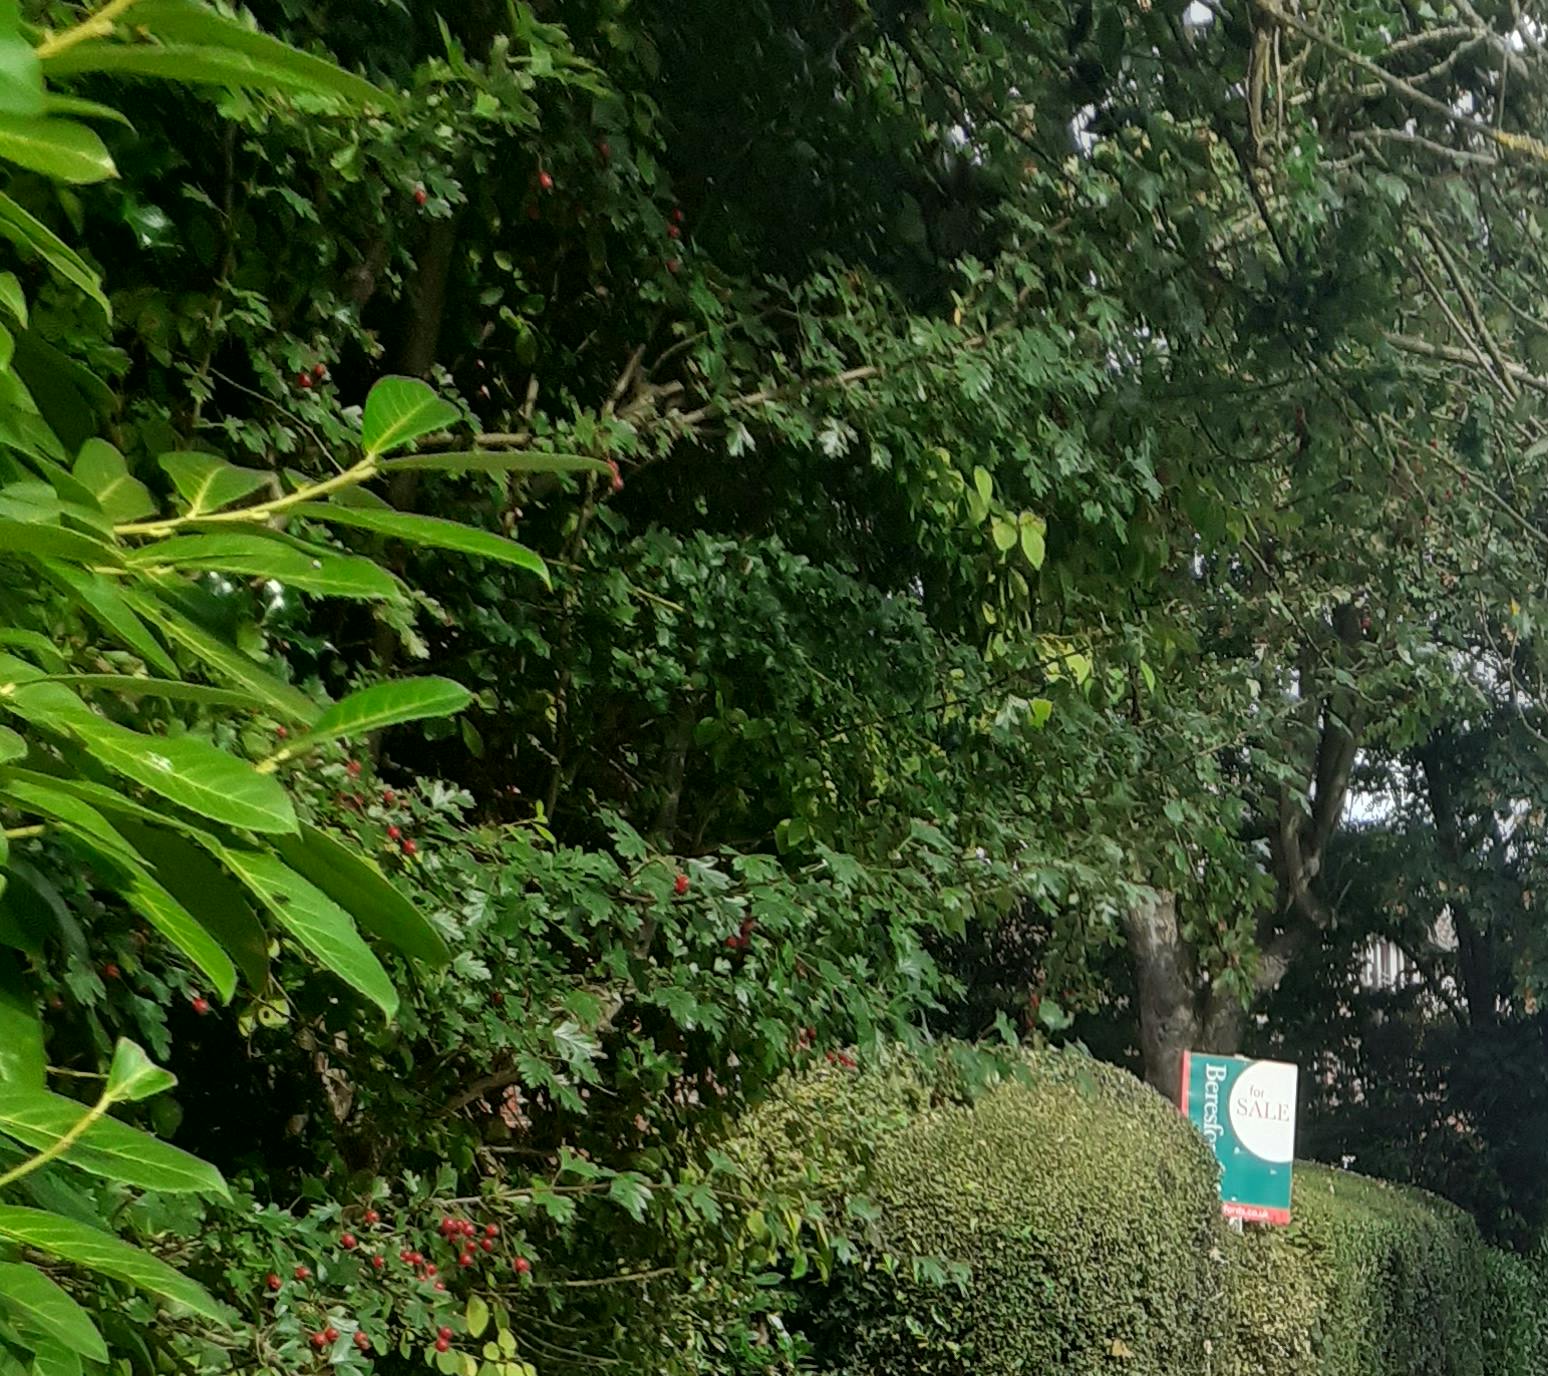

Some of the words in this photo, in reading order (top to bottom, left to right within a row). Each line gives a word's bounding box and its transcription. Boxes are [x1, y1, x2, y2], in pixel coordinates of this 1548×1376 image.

[1249, 1085, 1264, 1099] for
[1203, 1063, 1227, 1171] Beresfo
[1236, 1097, 1290, 1122] SALE
